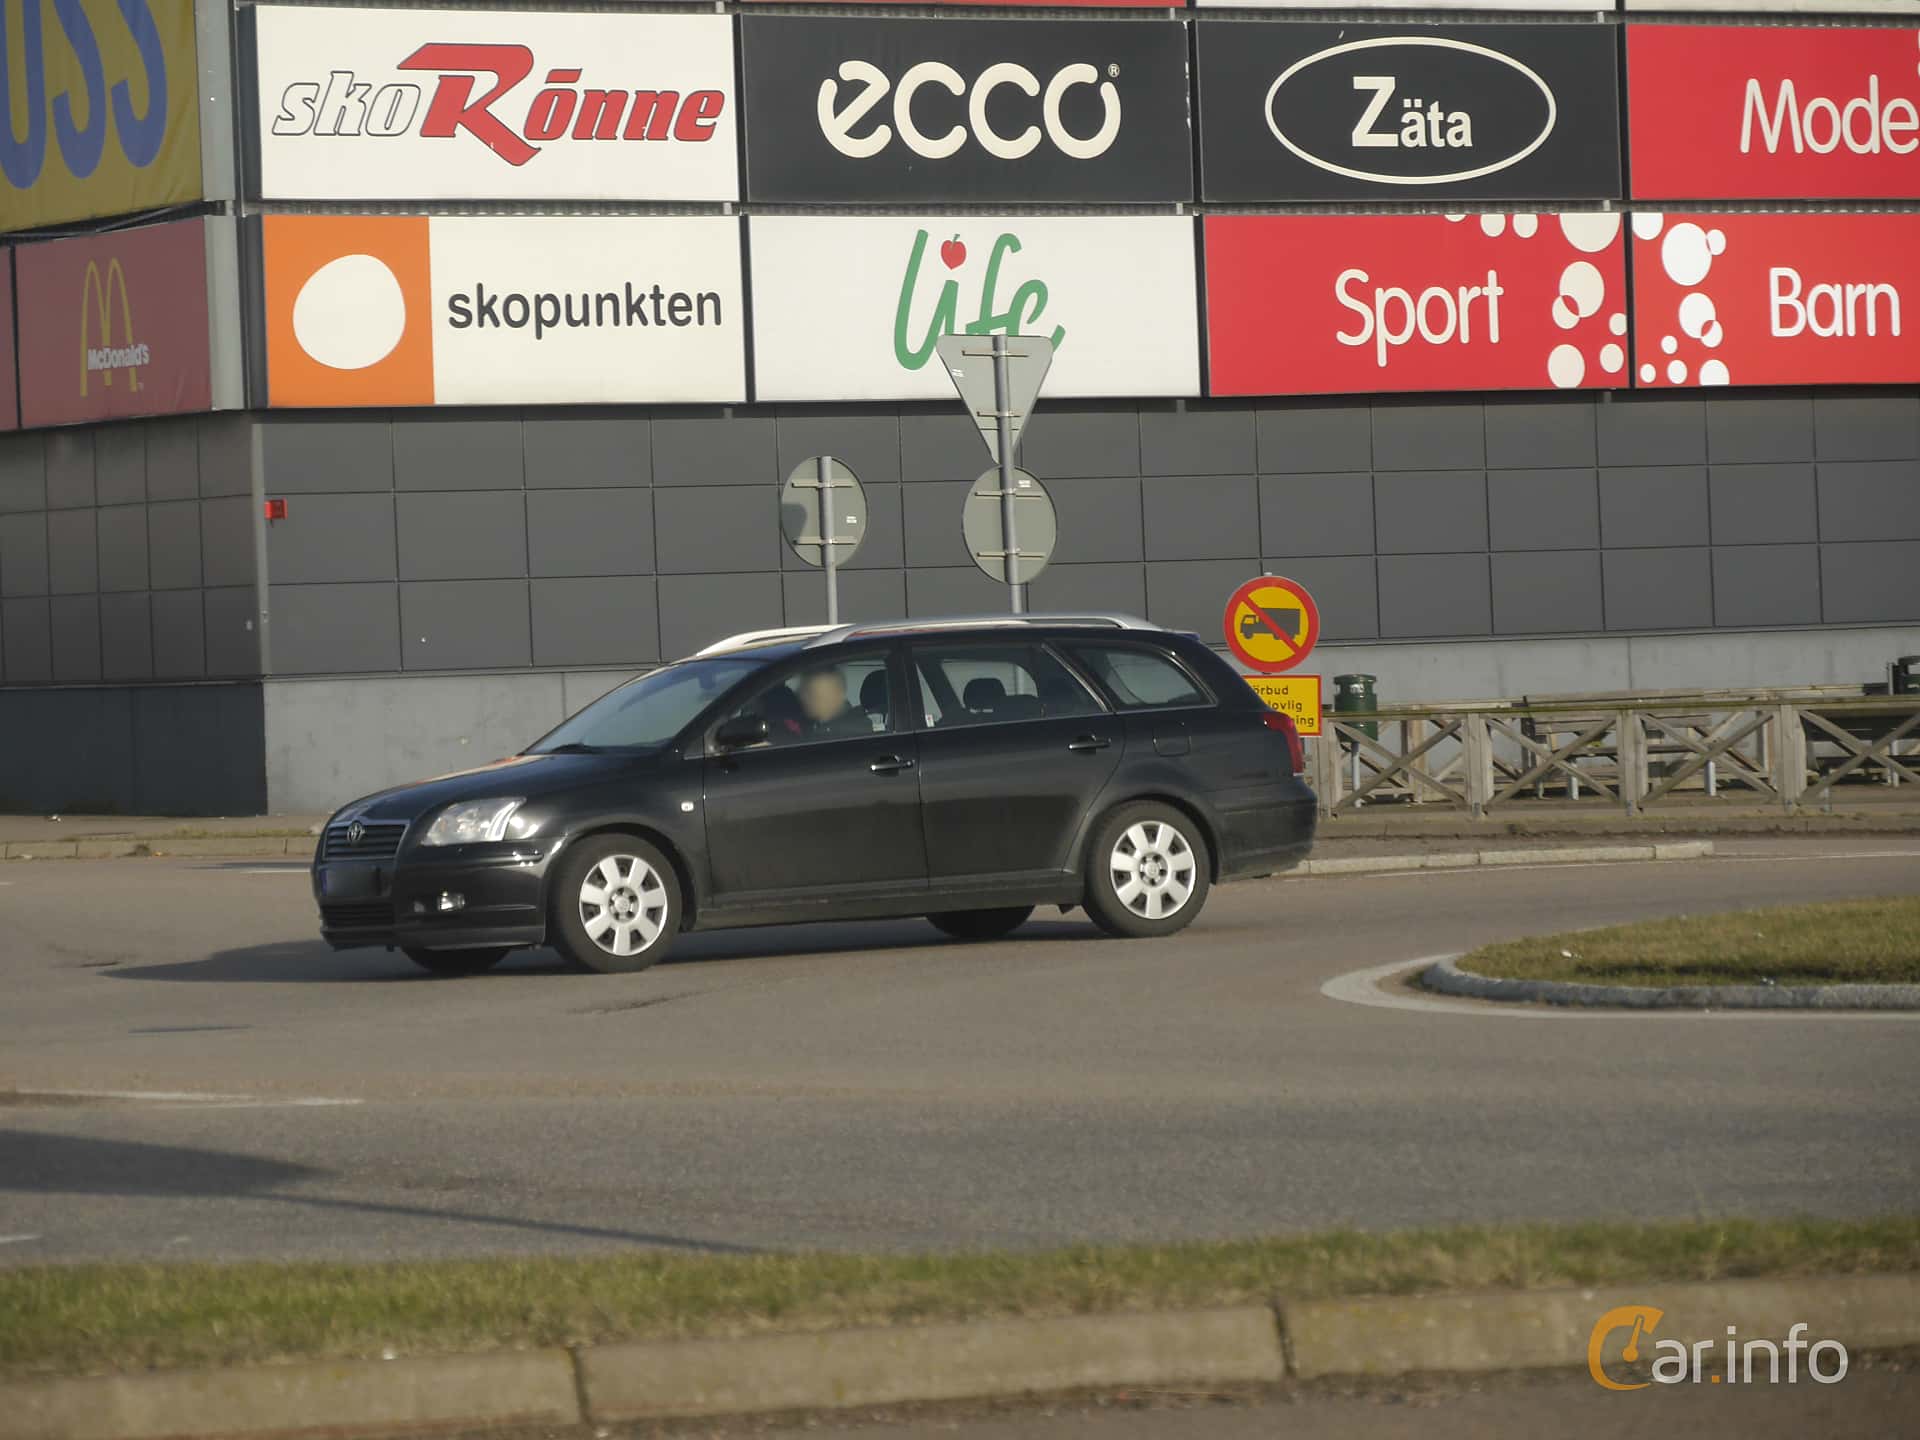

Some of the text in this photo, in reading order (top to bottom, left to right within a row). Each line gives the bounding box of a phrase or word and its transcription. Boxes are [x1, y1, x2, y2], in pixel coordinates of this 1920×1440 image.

[1352, 76, 1473, 148] Zäta
[1740, 74, 1920, 154] Mode
[448, 282, 723, 340] skopunkten
[1335, 268, 1504, 367] Sport
[1769, 267, 1901, 337] Barn
[87, 344, 150, 371] McDonald's
[1253, 685, 1289, 695] örbud
